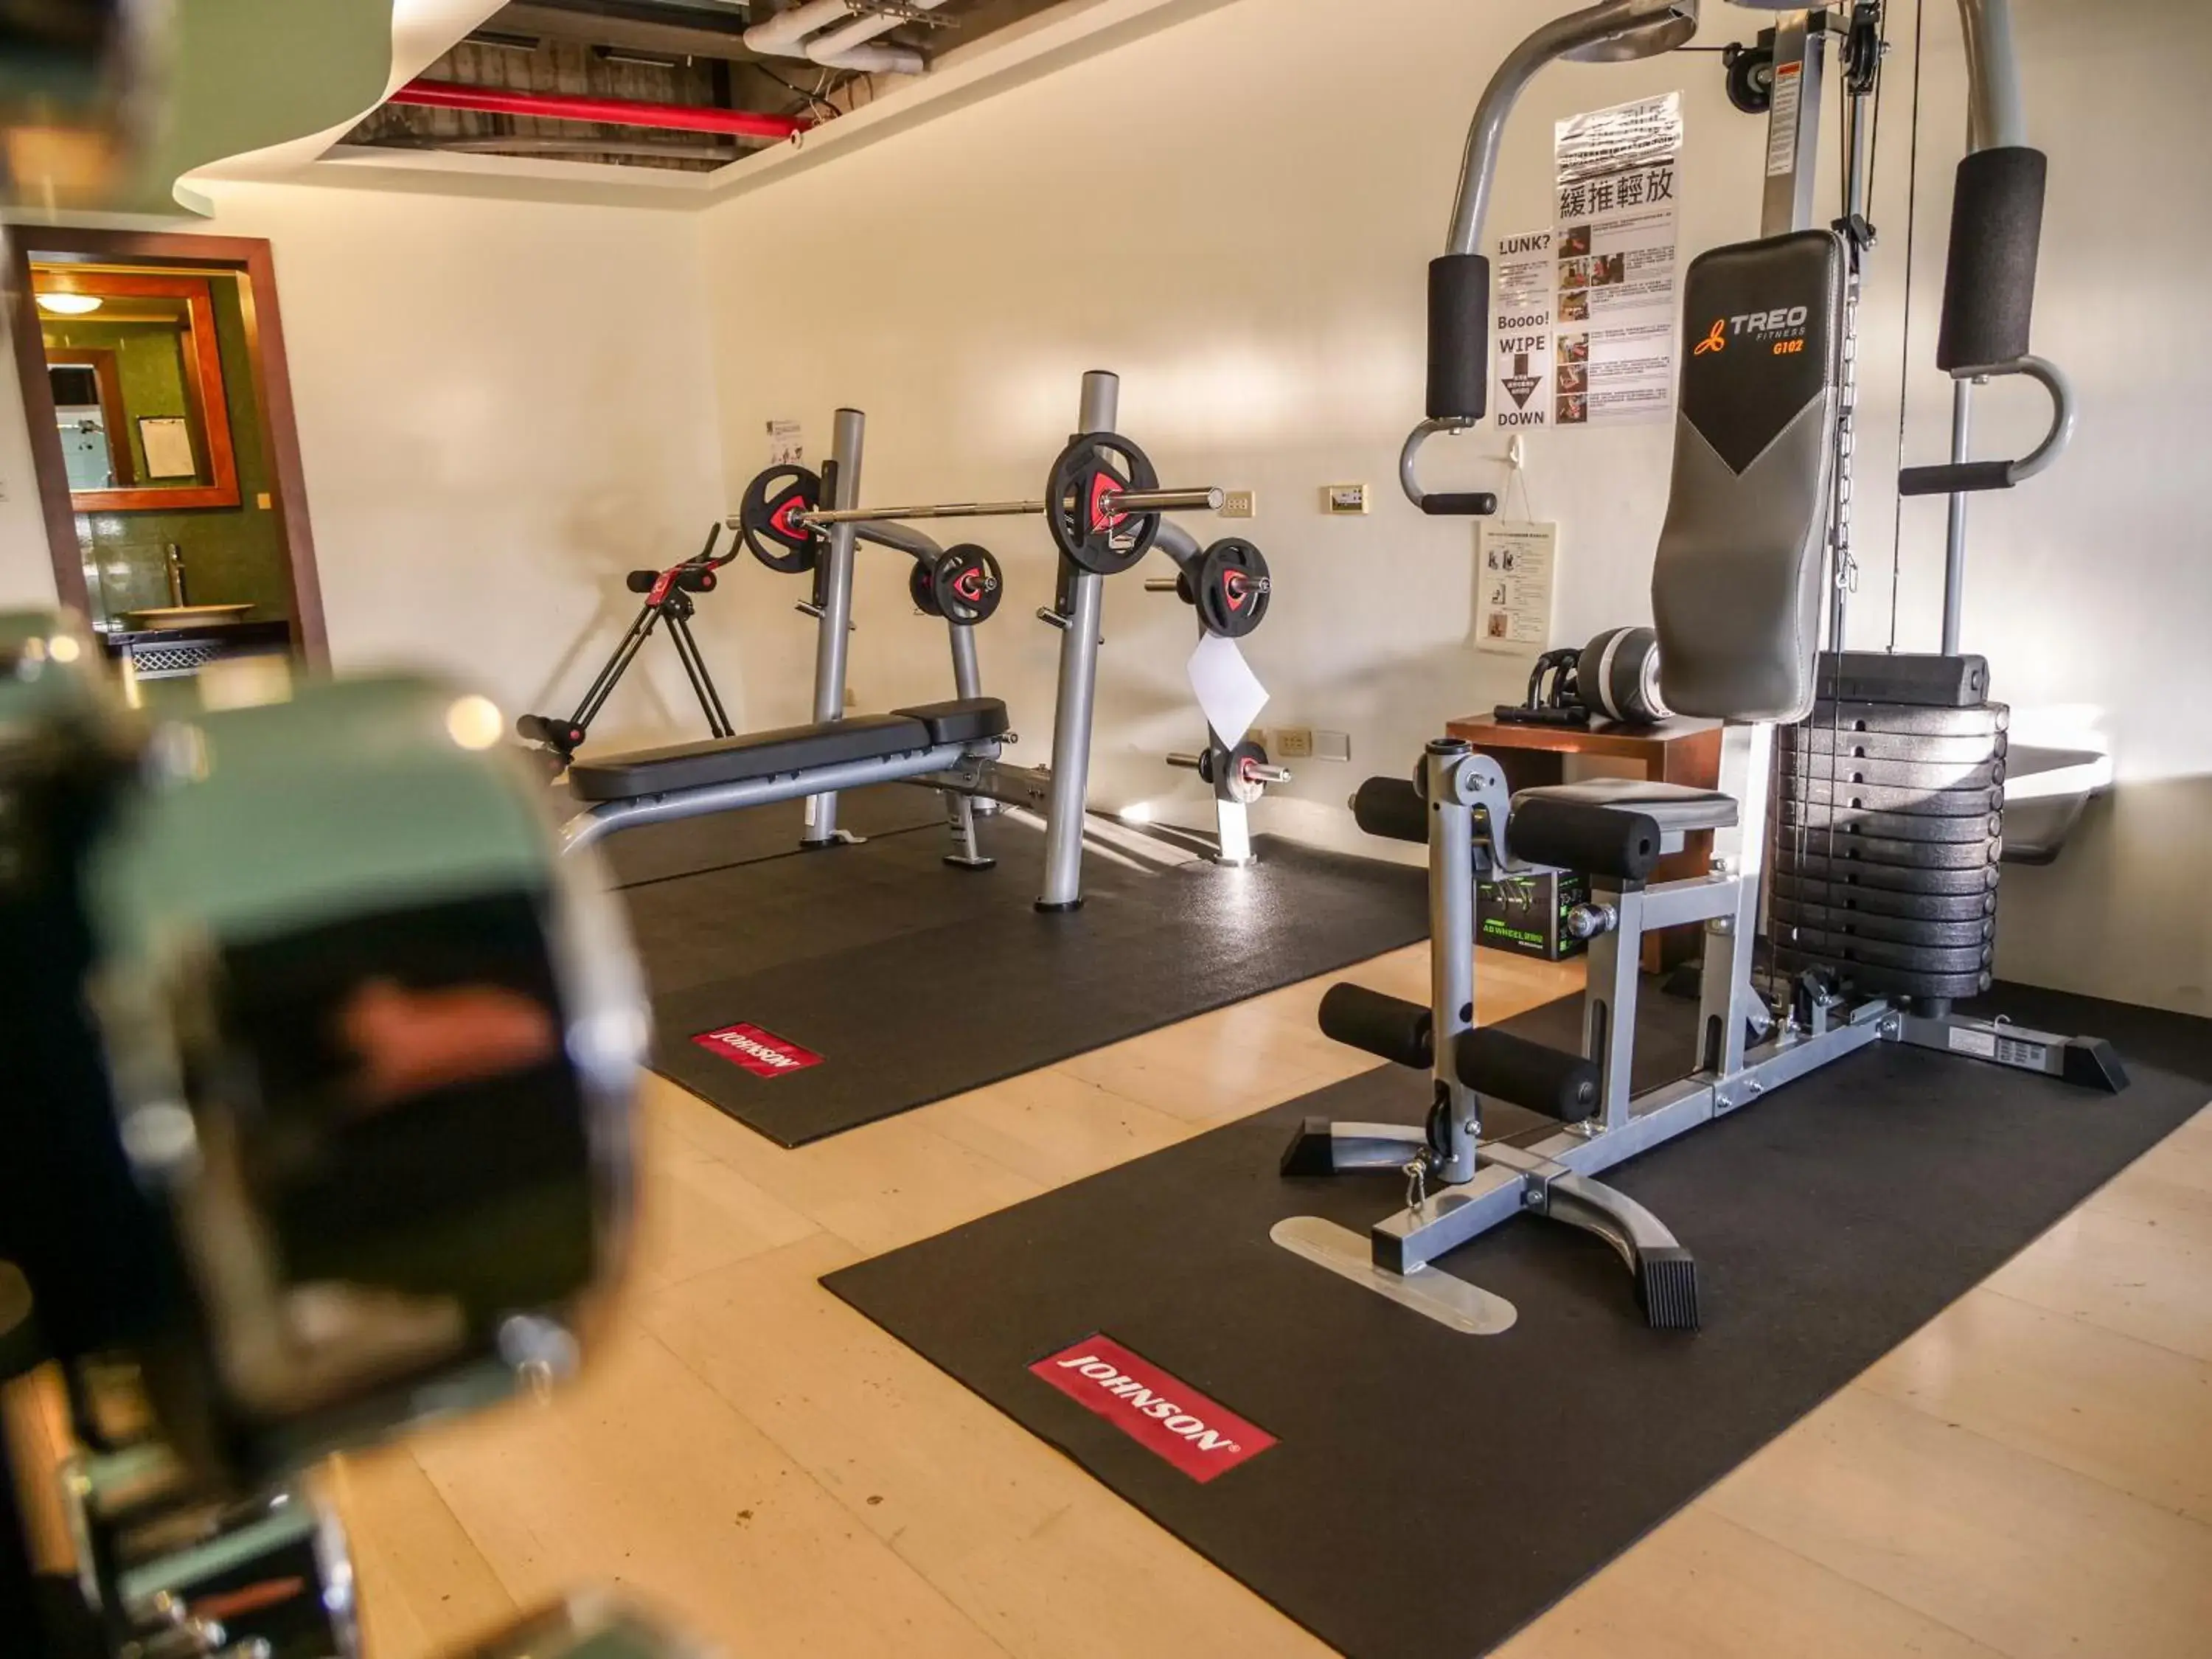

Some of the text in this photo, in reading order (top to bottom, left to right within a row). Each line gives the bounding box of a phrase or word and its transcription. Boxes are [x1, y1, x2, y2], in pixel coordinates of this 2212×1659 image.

[1559, 167, 1674, 218] 緩推輕放
[1499, 234, 1551, 254] LUNK?
[1498, 310, 1549, 330] Boooo!
[1731, 306, 1807, 335] TREO
[1500, 335, 1545, 353] WIPE
[1756, 327, 1806, 341] FITNESS
[1773, 339, 1804, 355] G102
[1498, 411, 1544, 426] DOWN
[709, 1032, 801, 1067] JOHNSON
